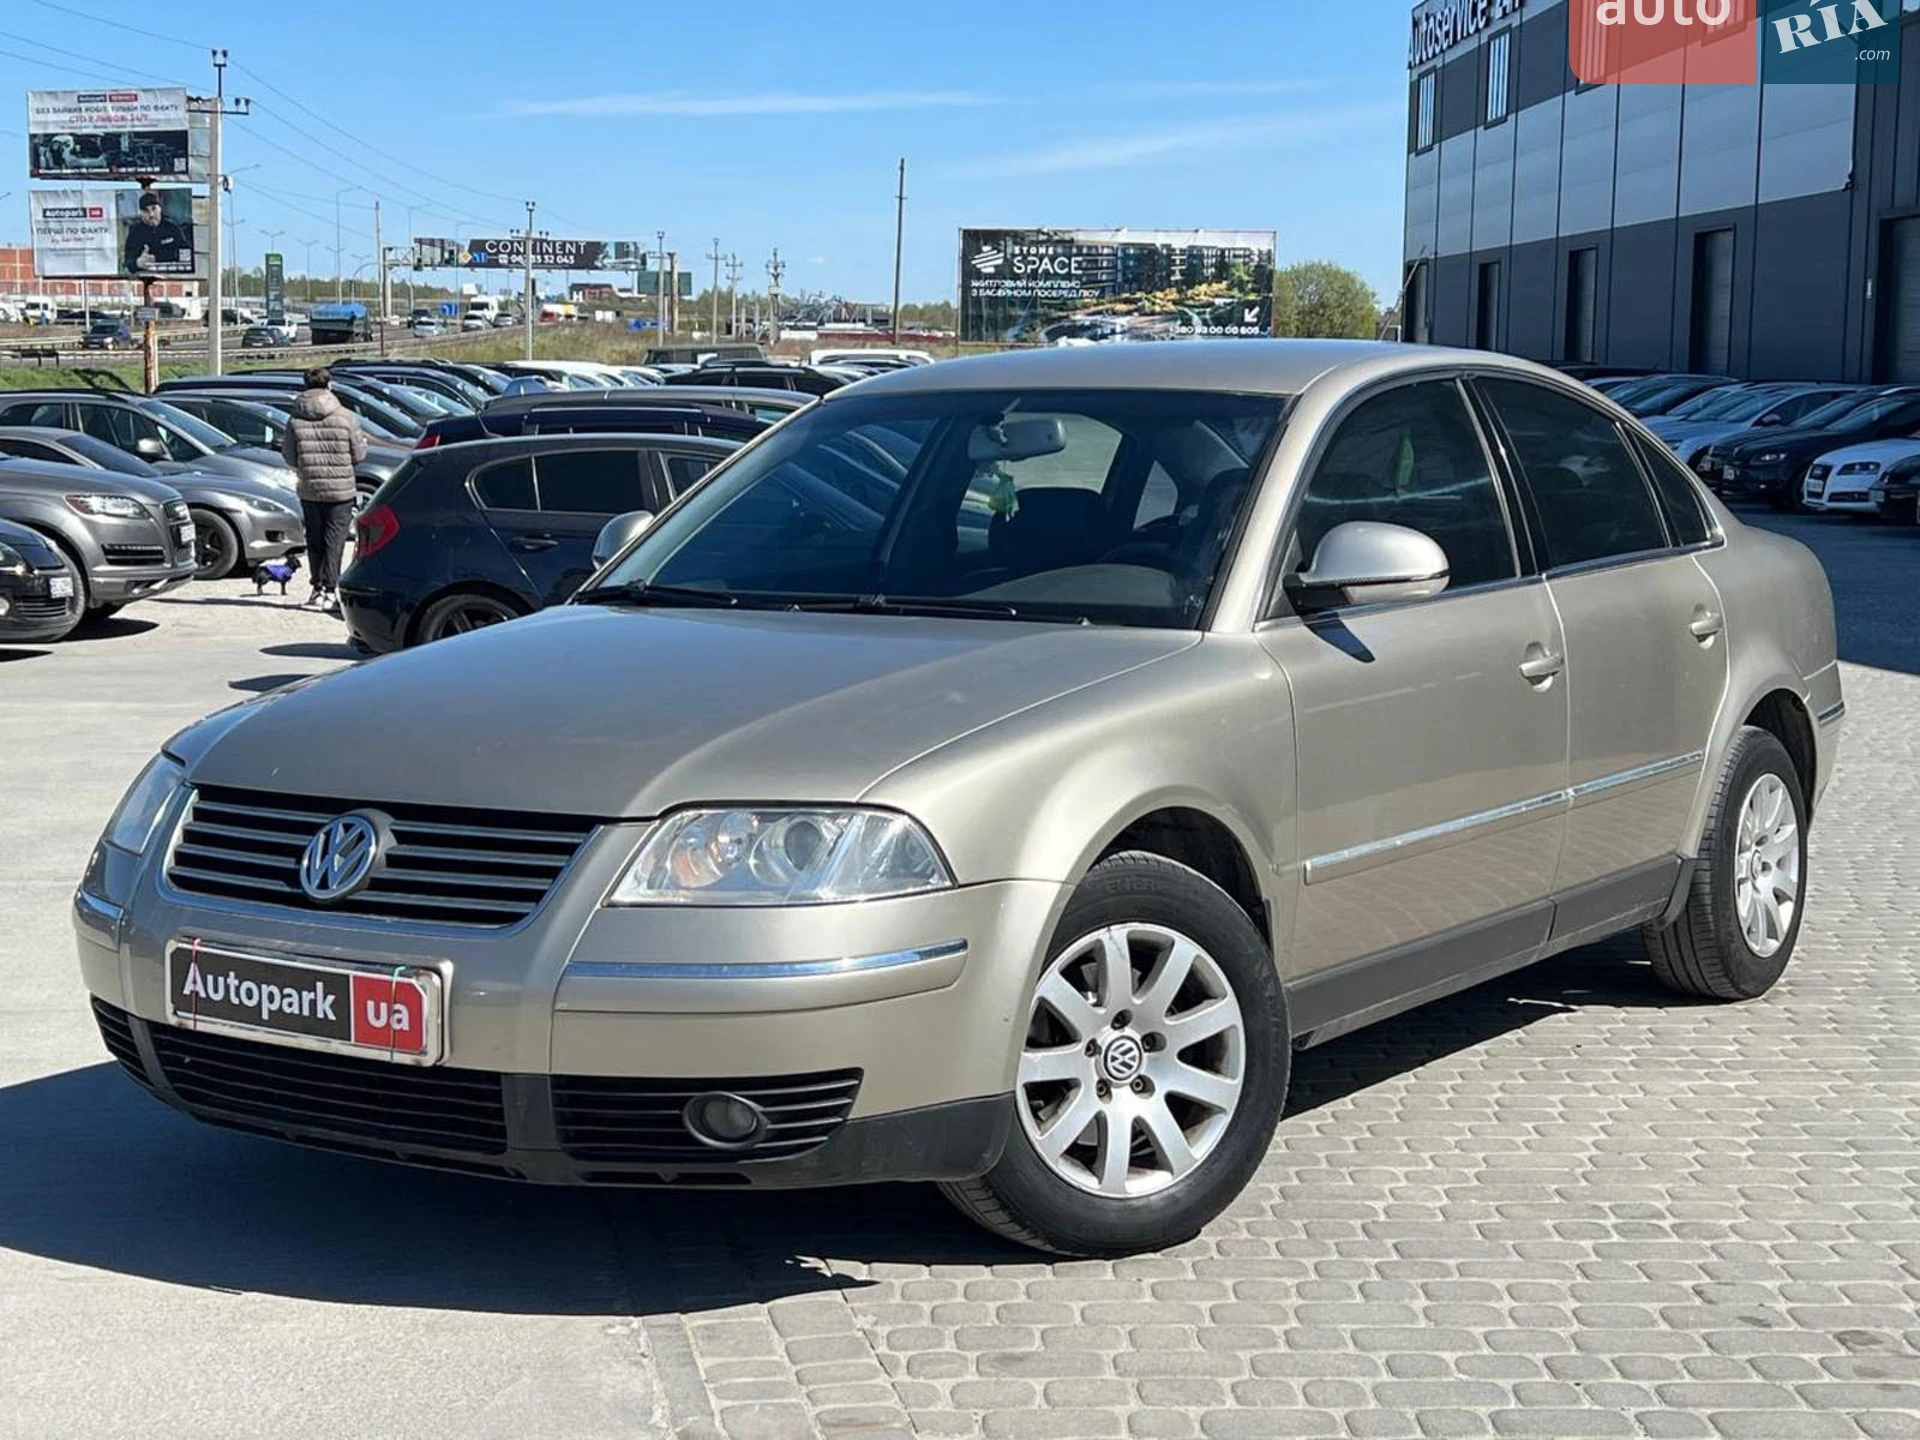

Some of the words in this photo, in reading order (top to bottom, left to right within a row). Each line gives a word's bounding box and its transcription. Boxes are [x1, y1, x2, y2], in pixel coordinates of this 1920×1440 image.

[45, 210, 84, 218] Autopark
[1013, 257, 1082, 274] SPACE
[183, 961, 336, 1020] Autopark
[366, 999, 410, 1031] ua
